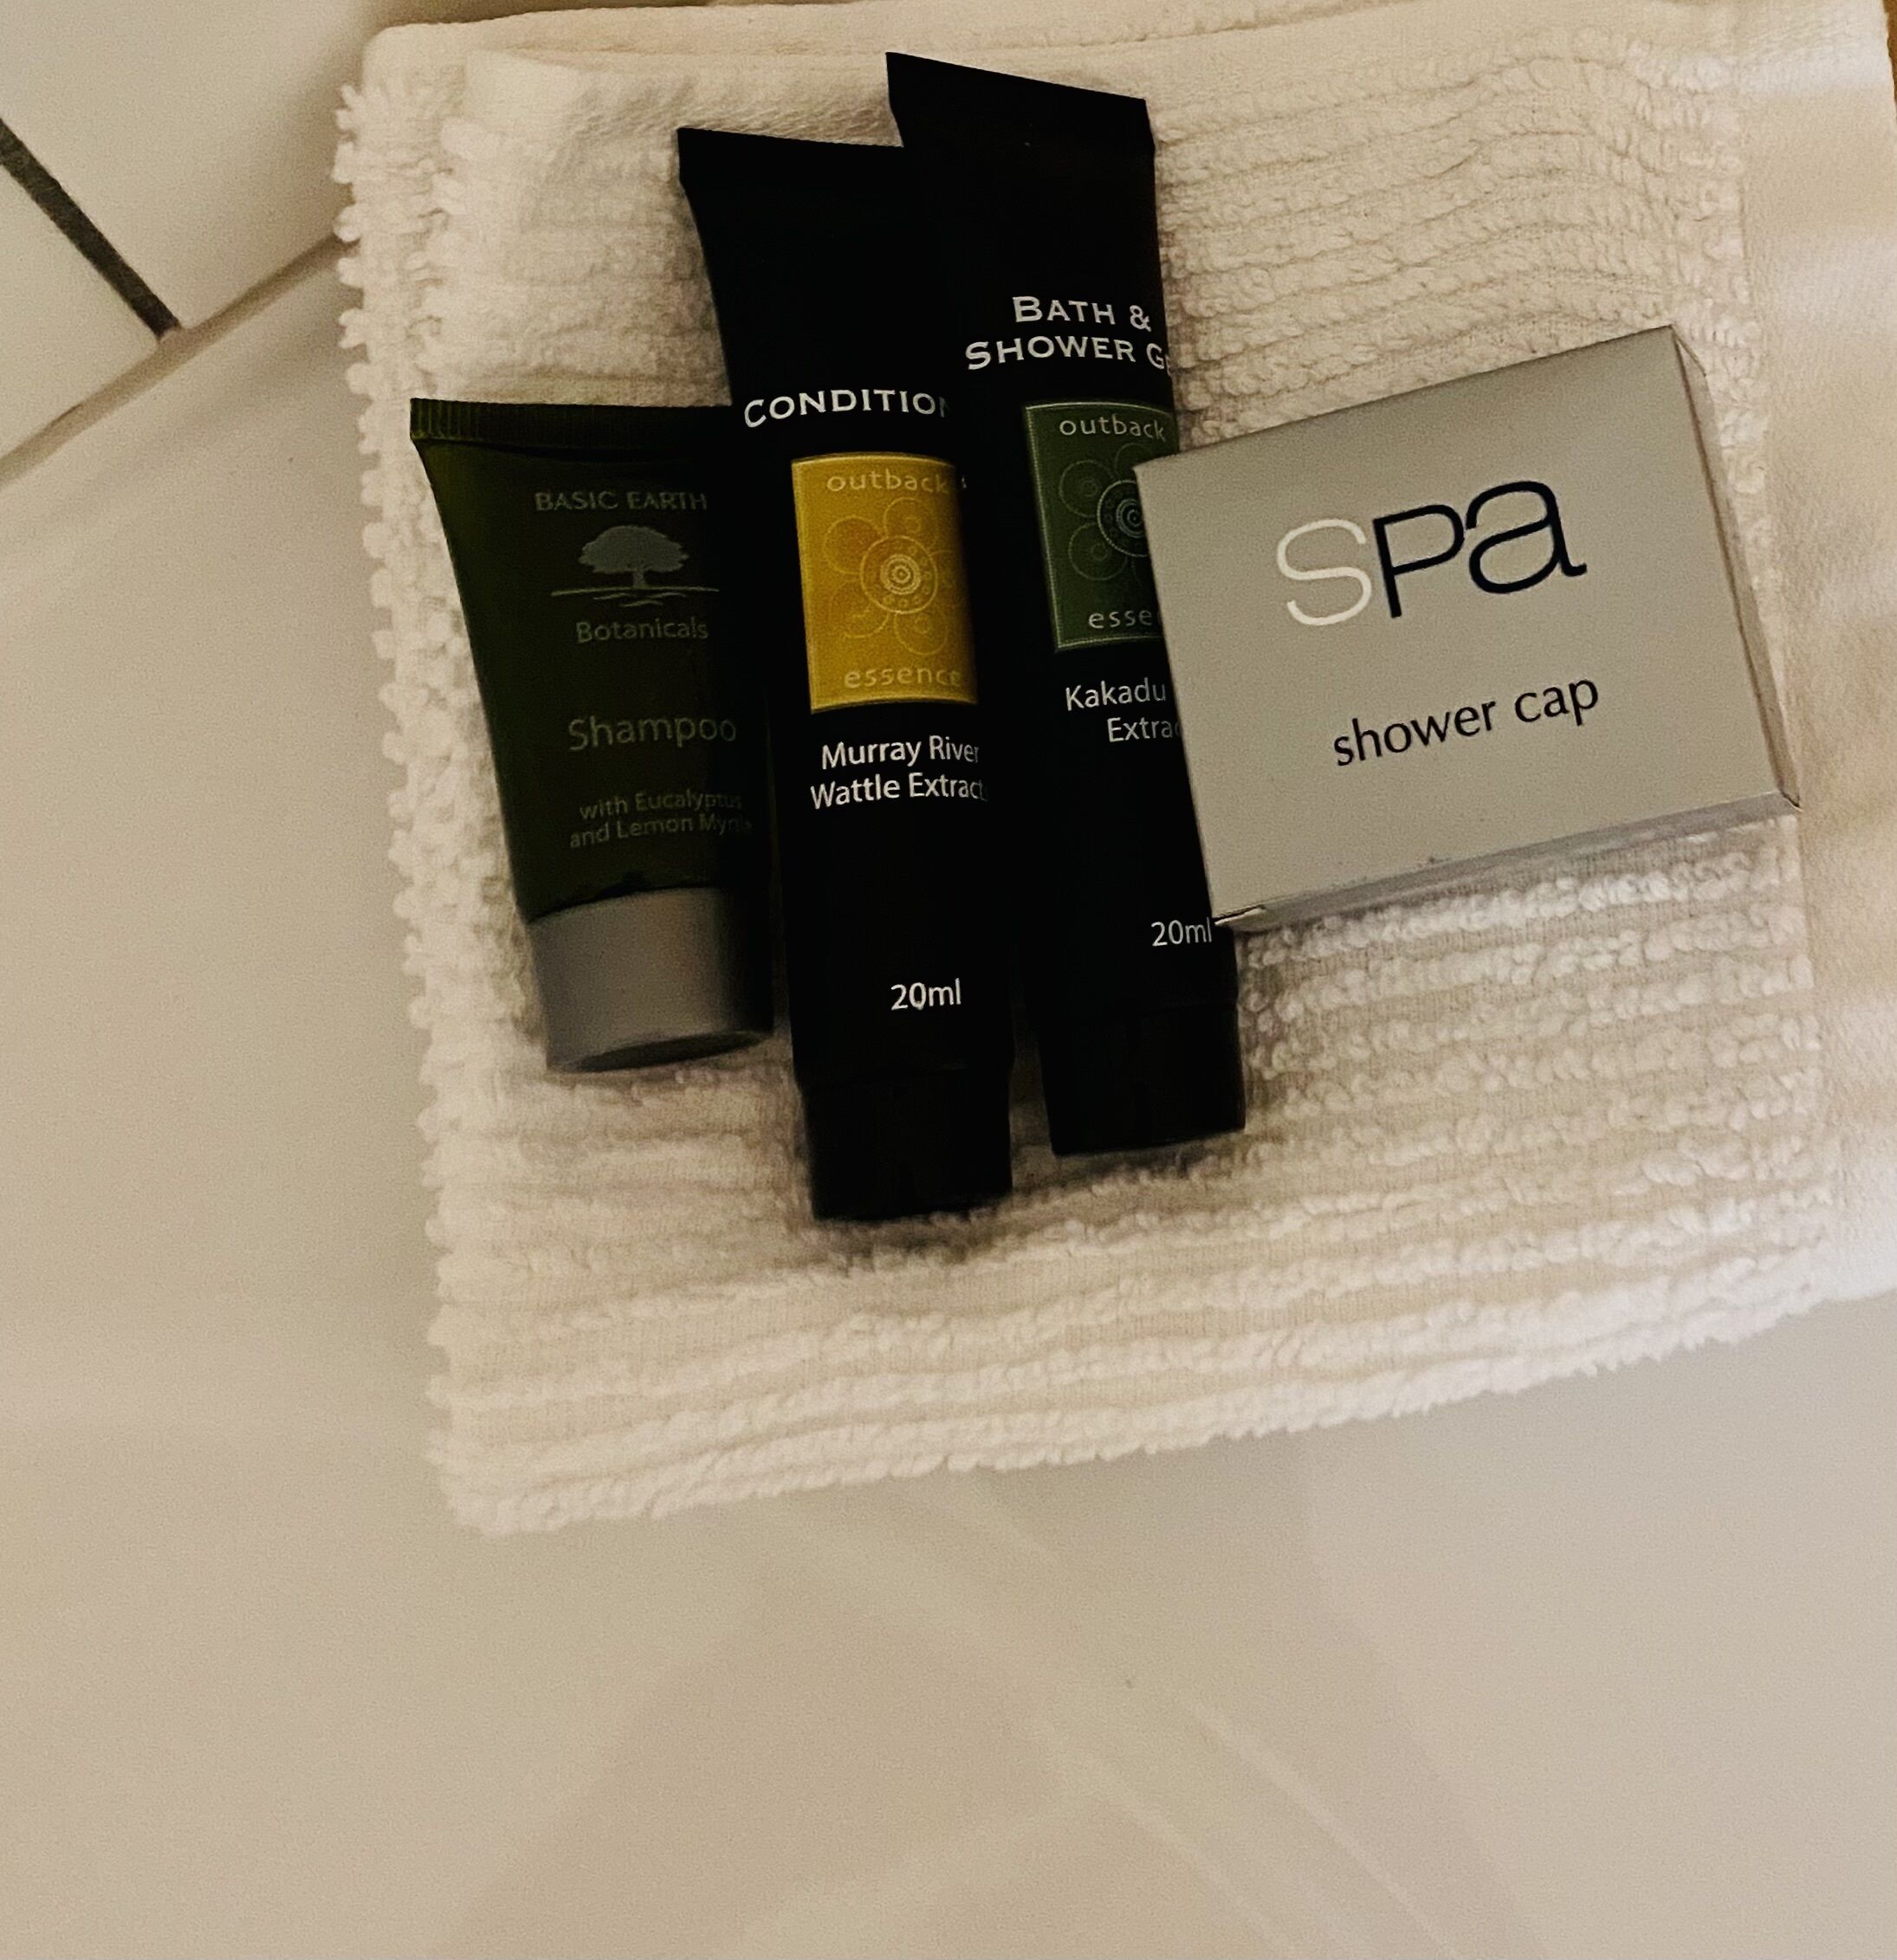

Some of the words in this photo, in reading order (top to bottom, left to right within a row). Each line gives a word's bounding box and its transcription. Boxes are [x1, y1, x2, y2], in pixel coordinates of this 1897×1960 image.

[1012, 295, 1116, 326] BATH
[1129, 304, 1152, 333] &
[964, 335, 1136, 371] SHOWER
[1146, 342, 1171, 377] G
[1059, 413, 1166, 443] outback
[826, 468, 948, 494] outback
[534, 490, 618, 511] BASIC
[625, 491, 708, 510] EARTH
[576, 616, 709, 644] Botanicals
[1088, 609, 1162, 630] esse
[1065, 676, 1167, 711] Kakadu
[568, 715, 736, 751] Shampoo
[1334, 701, 1495, 767] shower
[1515, 679, 1598, 726] cap
[822, 741, 923, 770] Murray
[929, 734, 980, 765] River
[579, 795, 628, 820] with
[635, 788, 742, 813] Eucalyptus
[810, 773, 901, 810] Wattle
[570, 822, 610, 849] and
[616, 817, 694, 839] Lemon
[1150, 918, 1213, 948] 20ml
[890, 978, 962, 1012] 20ml
